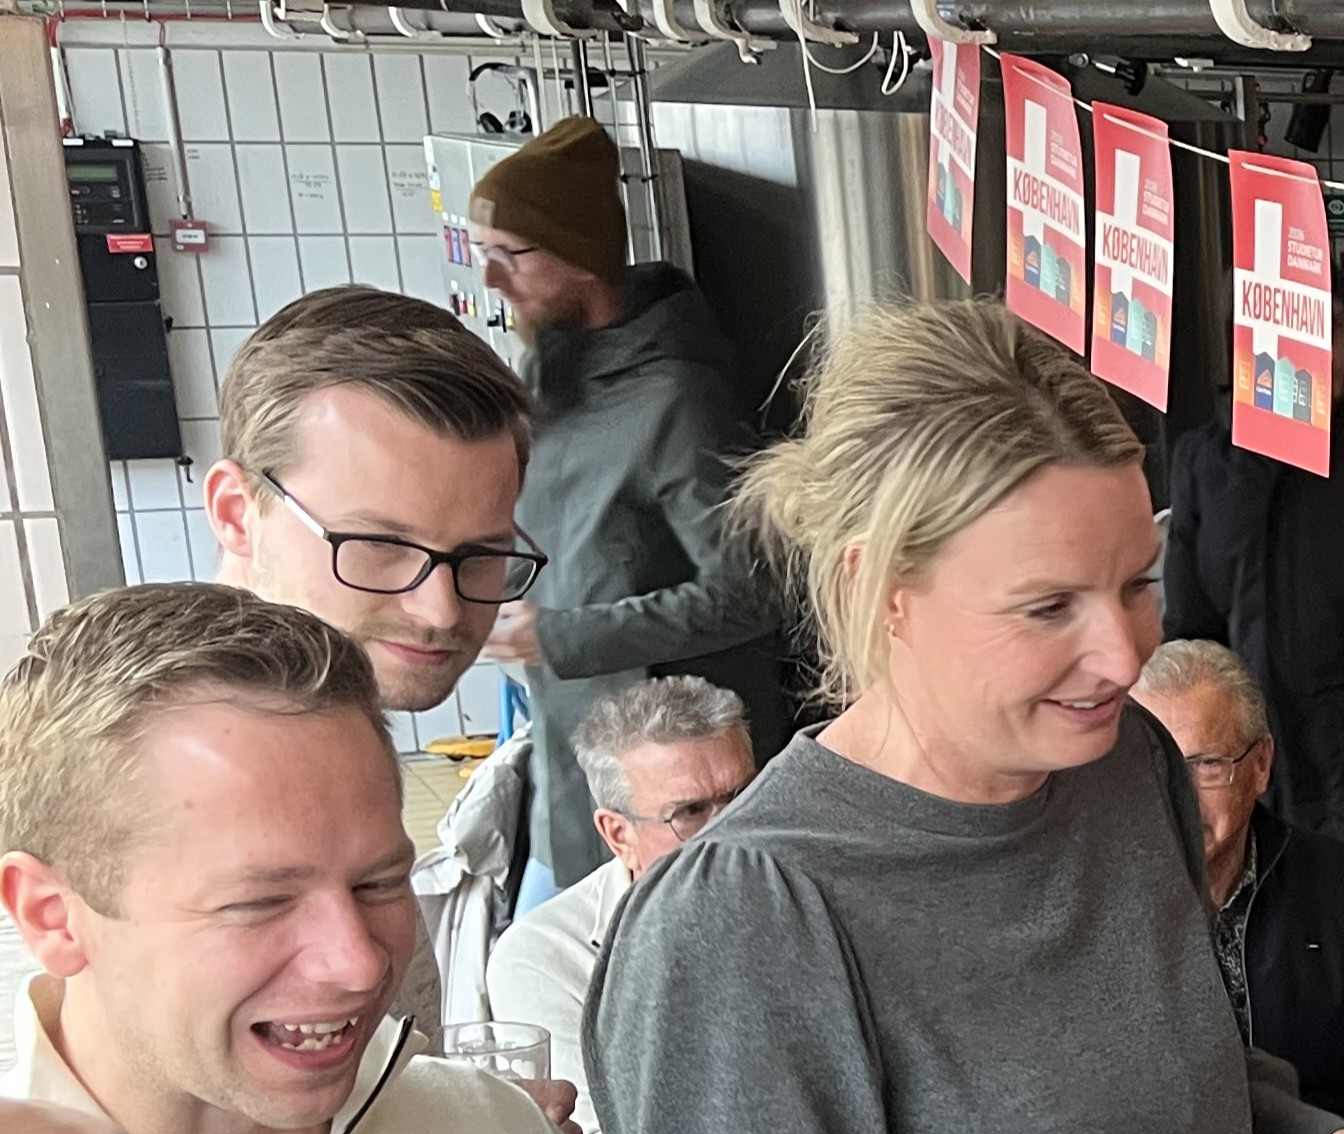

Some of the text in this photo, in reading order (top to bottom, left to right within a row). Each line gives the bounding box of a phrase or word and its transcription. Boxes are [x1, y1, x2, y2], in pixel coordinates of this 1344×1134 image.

[1013, 167, 1080, 236] KØBENHAVN
[1102, 222, 1169, 285] KØBENHAVN
[1242, 279, 1325, 339] KØBENHAVN
